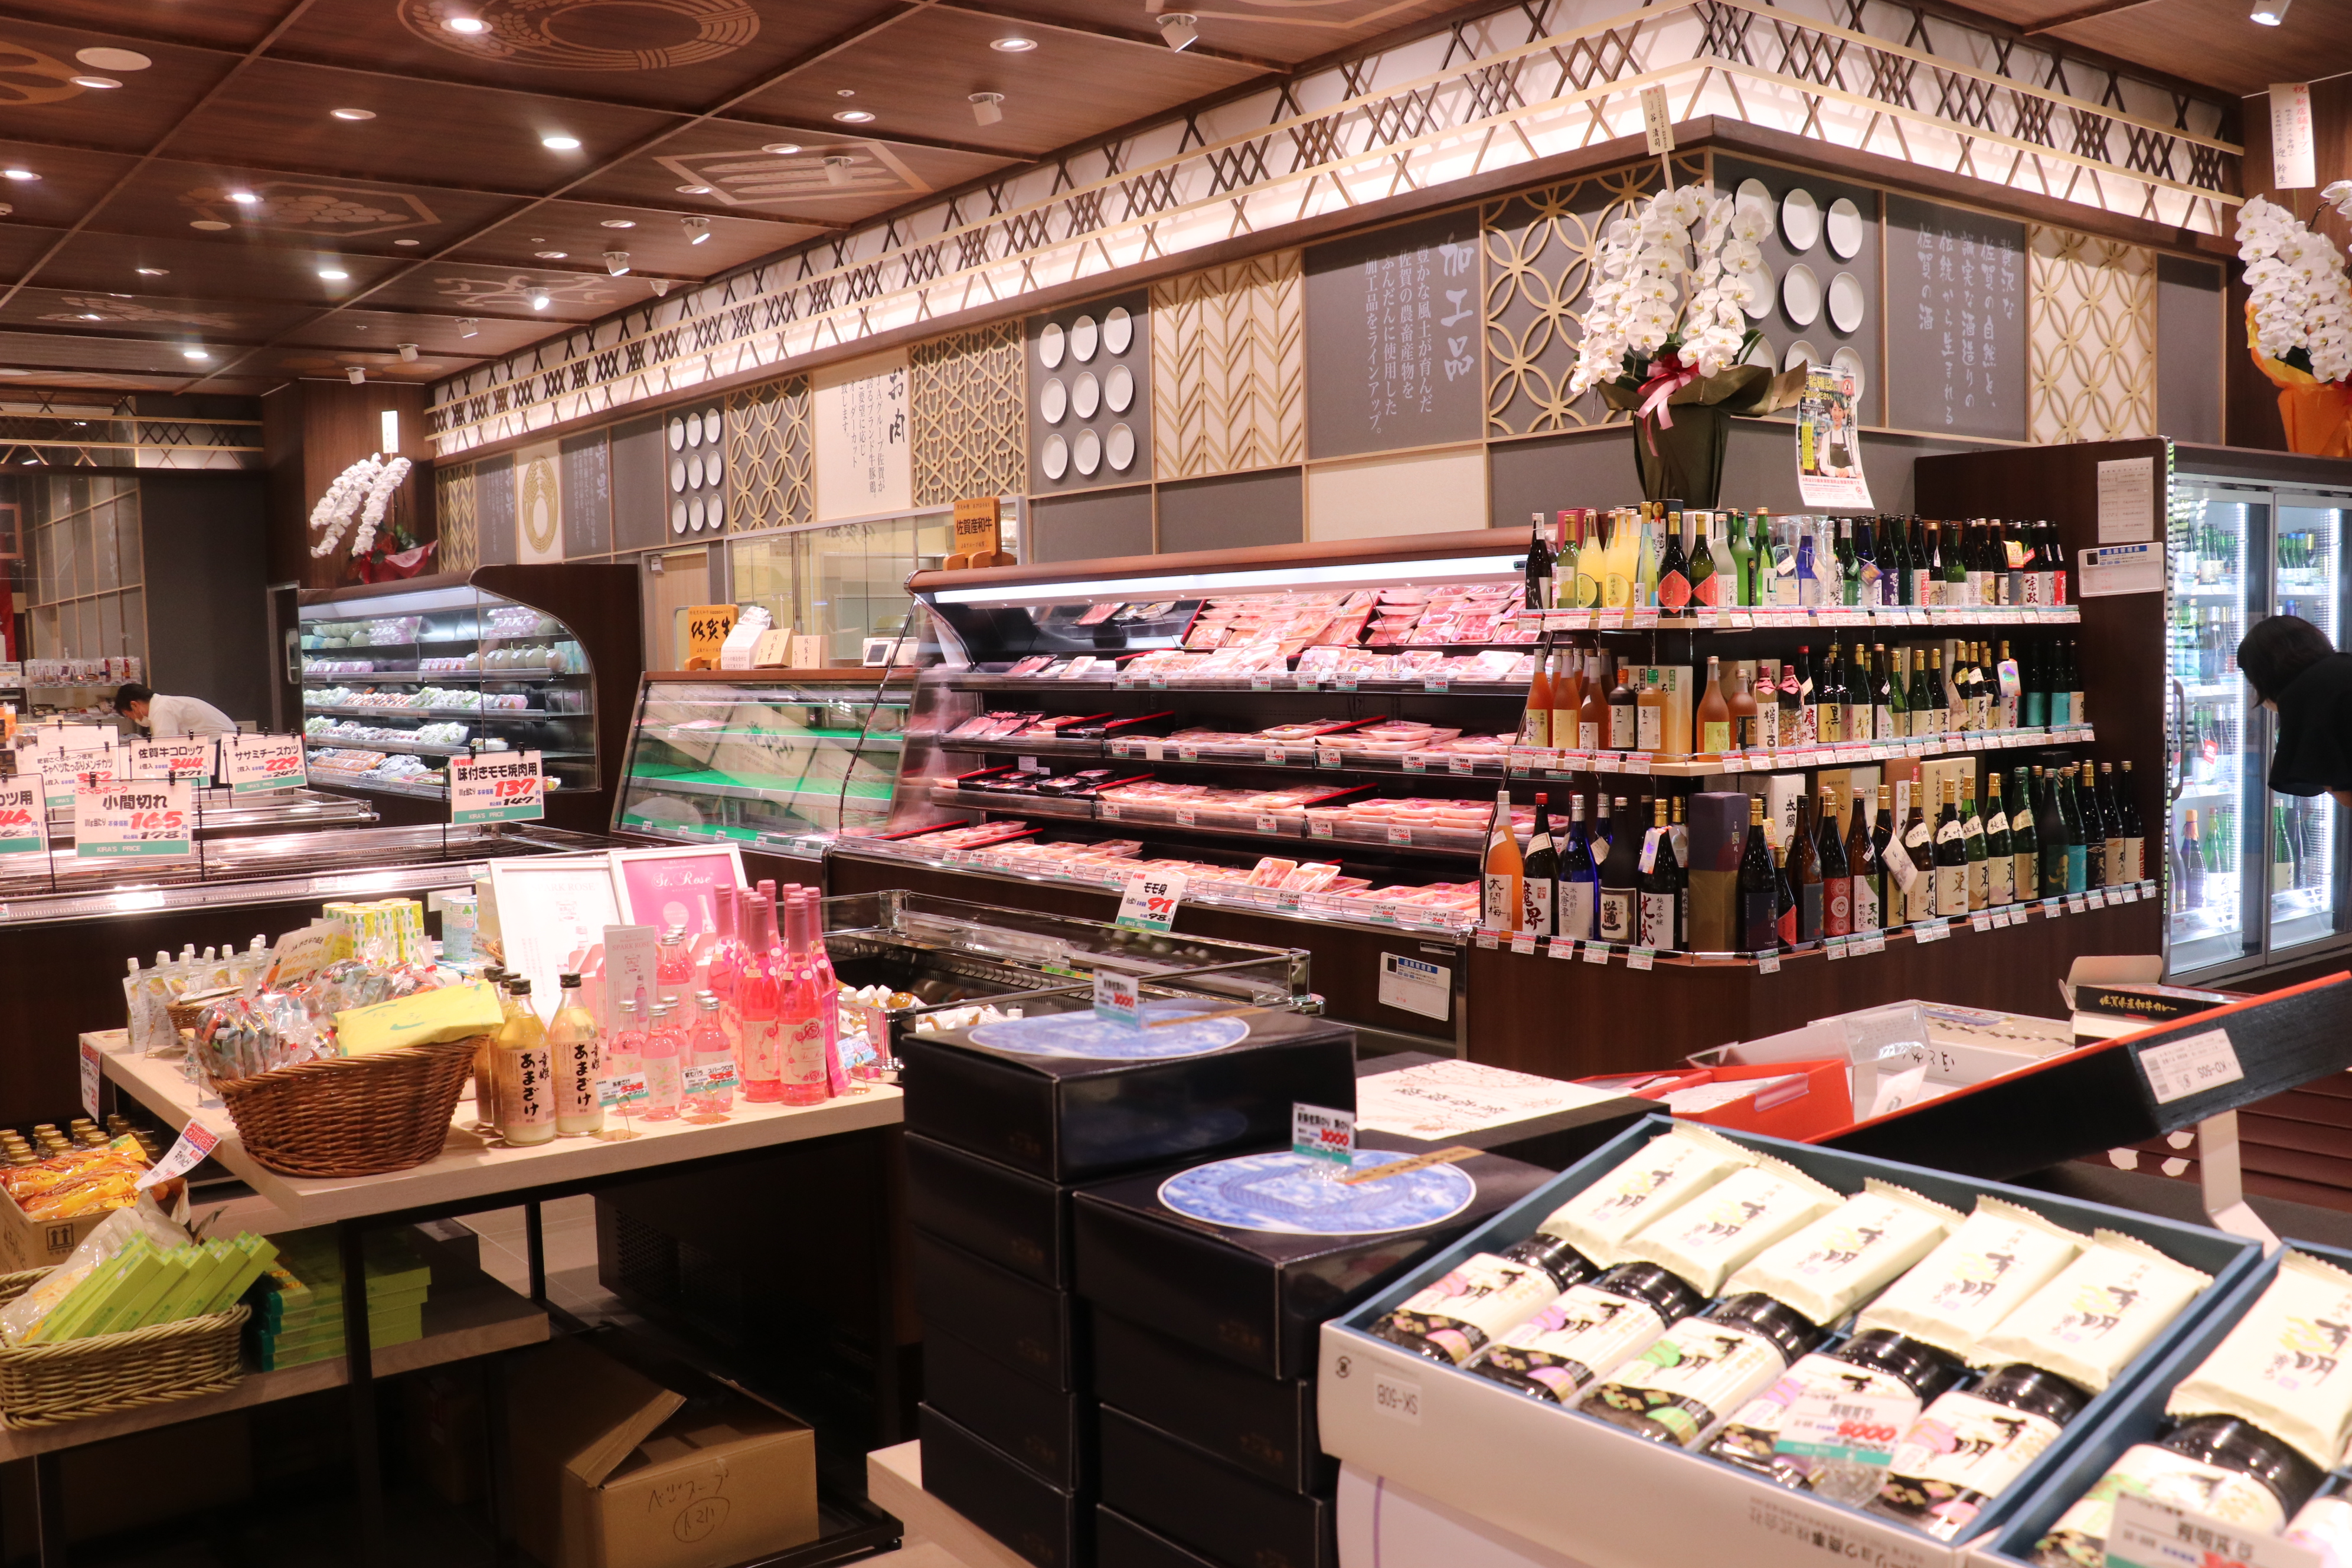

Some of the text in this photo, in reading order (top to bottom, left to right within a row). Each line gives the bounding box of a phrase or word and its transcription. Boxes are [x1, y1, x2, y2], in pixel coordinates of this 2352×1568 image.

[2295, 98, 2309, 155] 新店舗オープン
[1917, 222, 1933, 330] 佐賀の酒
[2000, 239, 2015, 320] 贅沢な
[1438, 231, 1475, 382] 加工品
[1399, 249, 1414, 400] 佐賀の農畜産物を
[1417, 245, 1432, 413] 豊かな風土が育んだ
[1939, 229, 1955, 424] 伝統から生まれる
[1961, 230, 1975, 407] 誠実な酒造りの
[1365, 257, 1381, 434] 加工品をラインアップ。
[1382, 254, 1397, 416] ふんだんに使用した
[1807, 375, 1838, 391] 齢確認に
[841, 383, 849, 437] 致します。
[888, 367, 905, 444] お肉
[956, 516, 992, 535] 佐賀産和牛
[2026, 574, 2039, 604] 宗政
[691, 616, 730, 642] 佐賀牛
[37, 753, 93, 765] 肥前さくらポーク使用
[139, 746, 204, 759] 佐賀牛コロッケ
[235, 745, 299, 760] ササミチーズカツ
[42, 759, 113, 773] キャベツたっぷりメンチカツ
[169, 757, 204, 770] 344
[265, 756, 299, 772] 229
[273, 769, 298, 778] 247
[458, 762, 537, 781] 味付きモモ焼肉用
[78, 786, 128, 795] さくらポーク
[494, 778, 537, 797] 137
[103, 795, 168, 810] 小間切れ
[503, 796, 534, 806] 147
[130, 811, 184, 830] 165
[140, 831, 179, 839] 178
[652, 870, 712, 890] St. Rose
[1144, 882, 1168, 896] モモ身
[1954, 870, 1966, 907] 東一
[1148, 897, 1175, 913] 91
[1488, 878, 1506, 917] 太閤梅
[1523, 880, 1544, 930] 魔界
[1560, 886, 1569, 917] 大唐津
[1655, 897, 1664, 926] 純米吟醸
[1404, 960, 1432, 972] 品質管理表
[2099, 995, 2178, 1012] 佐賀県産和牛カレー
[708, 1064, 734, 1073] スパークロゼ
[1902, 1050, 1955, 1072] ほとめ
[2197, 1059, 2229, 1080] KD-50S
[521, 1053, 540, 1116] あまざけ
[574, 1044, 592, 1106] あまざけ
